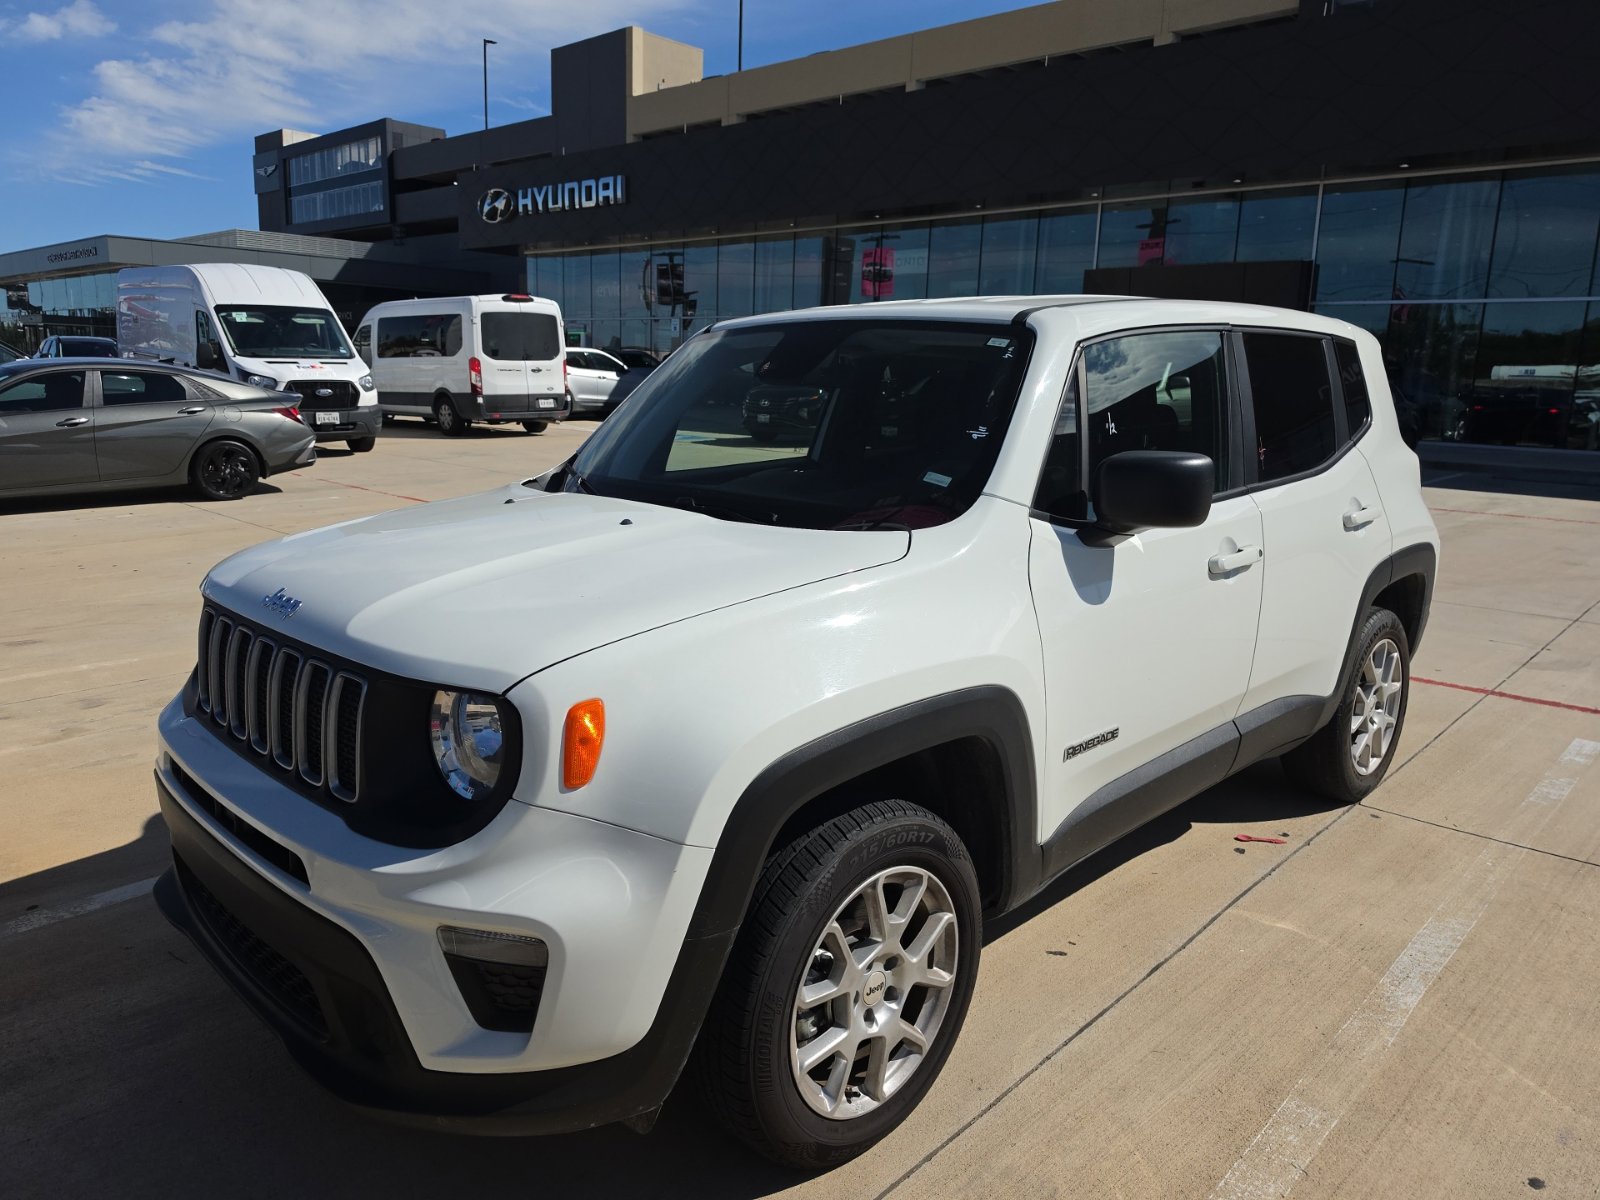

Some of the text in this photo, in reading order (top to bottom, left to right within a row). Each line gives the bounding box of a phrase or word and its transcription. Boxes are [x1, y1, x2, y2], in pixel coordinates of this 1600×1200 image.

[518, 175, 625, 216] HYUNDAI
[263, 588, 302, 620] Jeep
[1063, 727, 1119, 763] RENEGADE
[866, 982, 884, 996] Jeep
